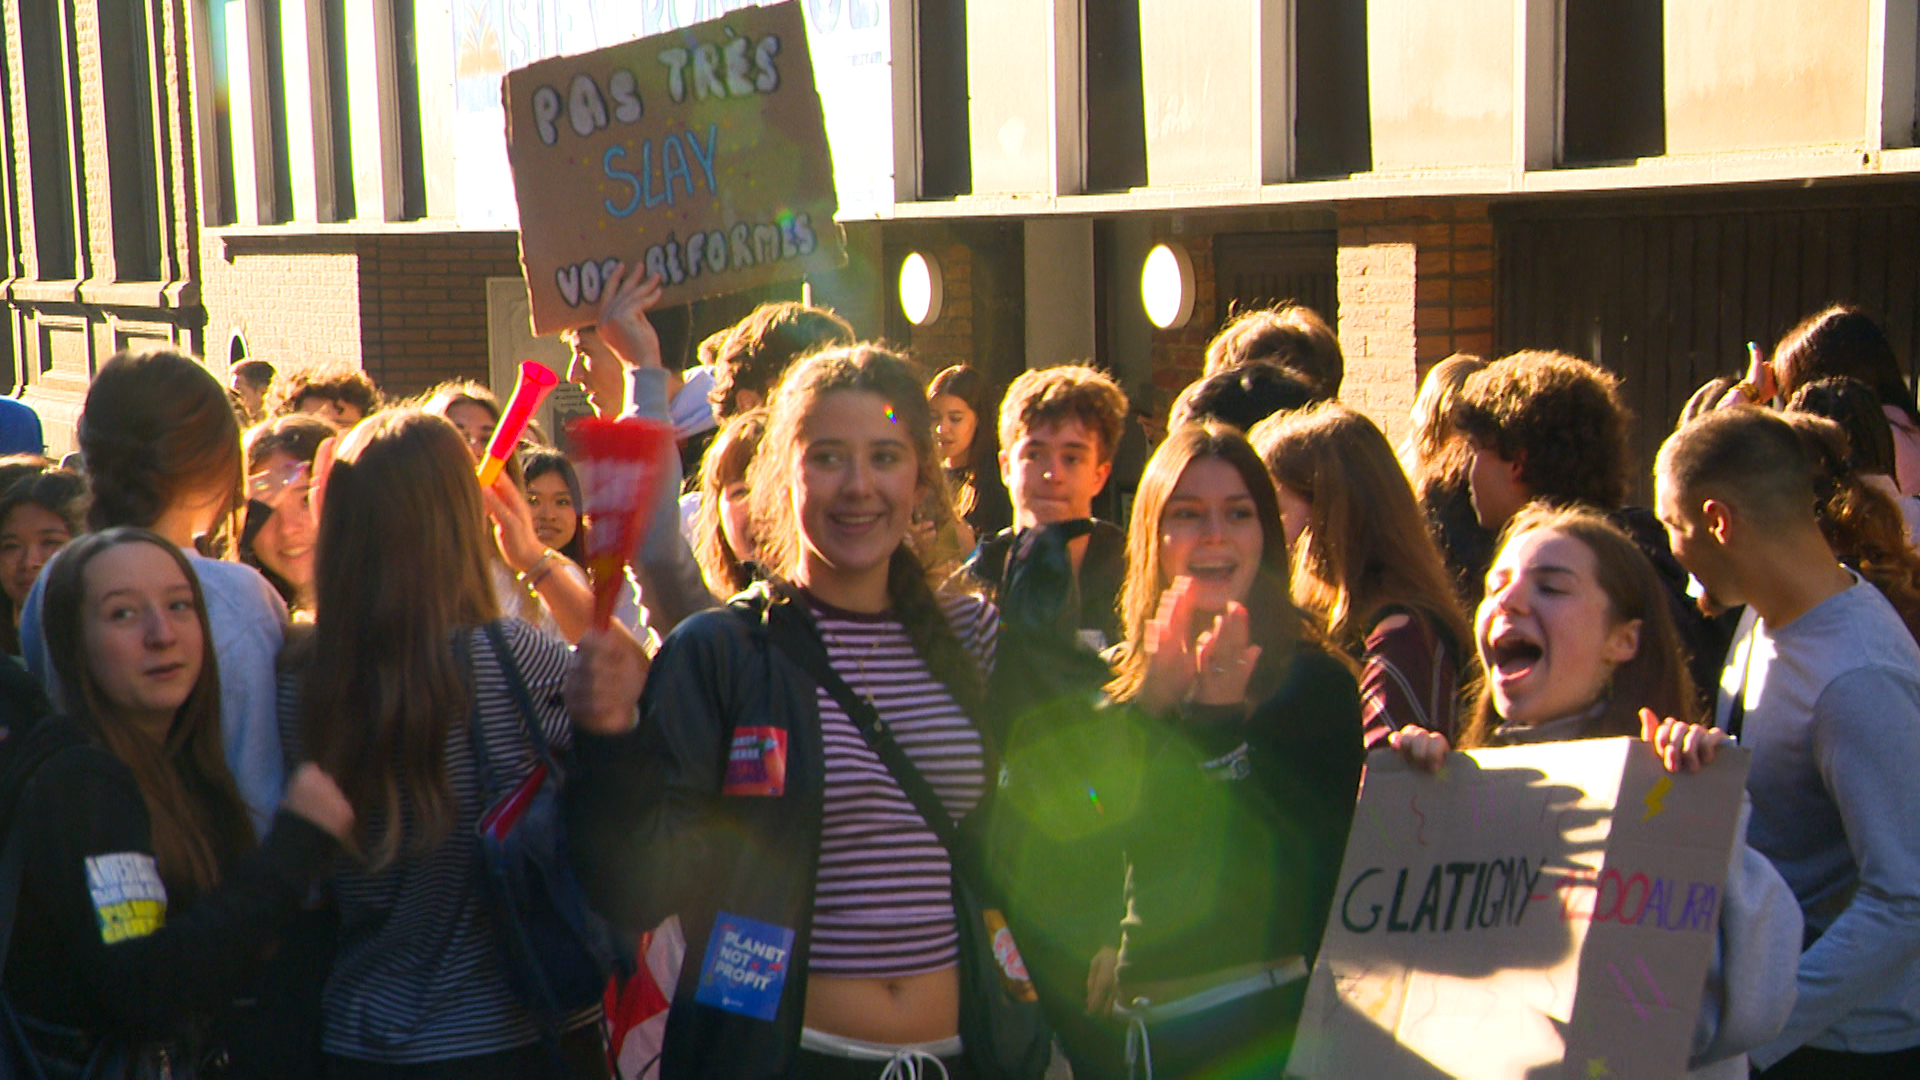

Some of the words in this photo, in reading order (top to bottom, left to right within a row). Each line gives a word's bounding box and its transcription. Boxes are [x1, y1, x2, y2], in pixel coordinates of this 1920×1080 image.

[532, 68, 643, 145] PAS
[658, 25, 780, 103] TRÈS
[602, 123, 718, 219] SLAY
[644, 213, 817, 287] RÉFORMES
[720, 946, 752, 969] NOT
[724, 931, 787, 963] PLANET
[714, 961, 772, 992] PROFIT
